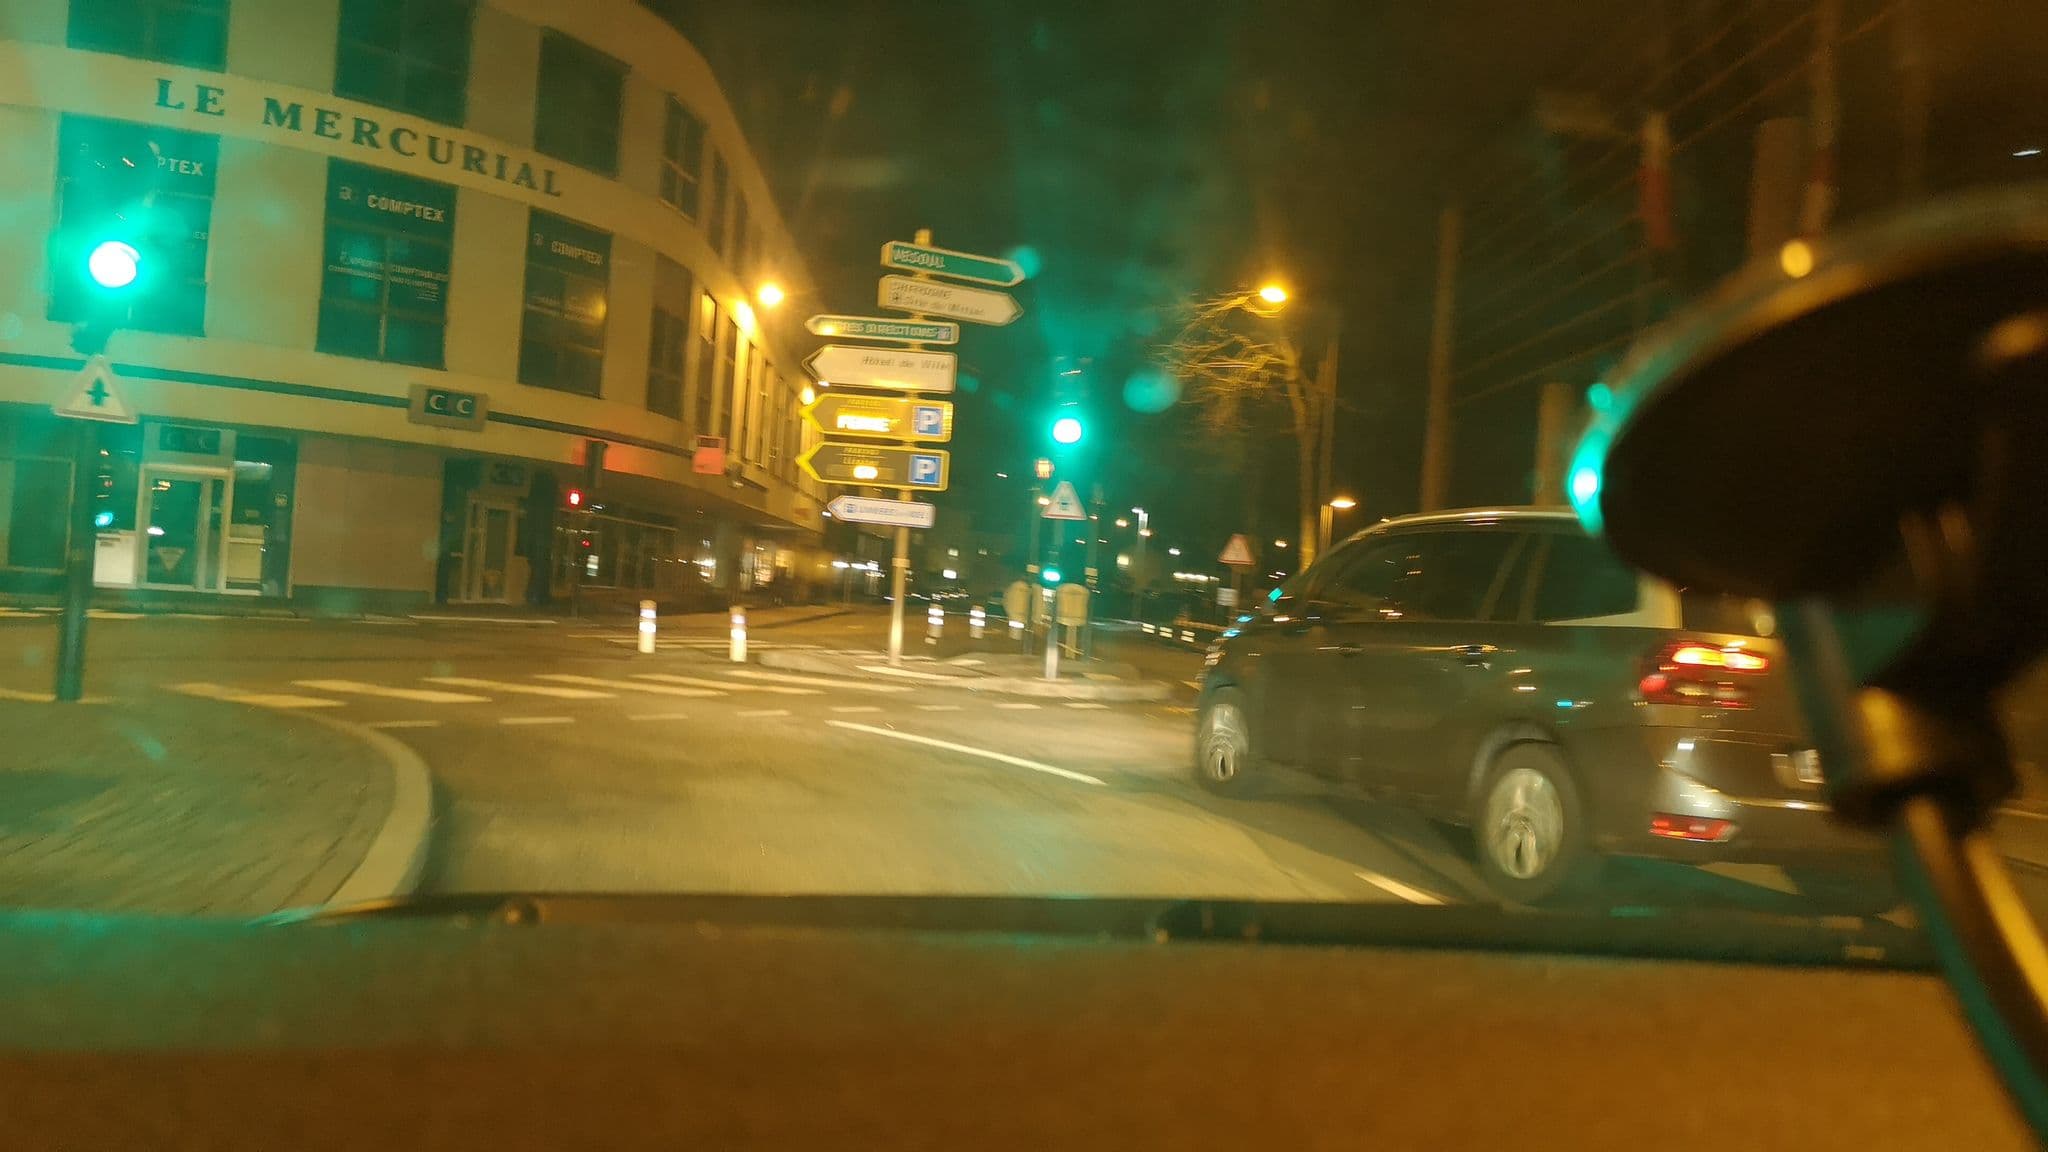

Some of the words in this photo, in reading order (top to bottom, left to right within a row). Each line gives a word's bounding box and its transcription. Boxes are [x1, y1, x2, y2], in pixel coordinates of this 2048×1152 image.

[155, 78, 225, 117] LE
[262, 96, 563, 197] MERCURIAL
[366, 194, 446, 222] COMPTEX
[918, 410, 939, 431] P
[914, 458, 937, 481] P
